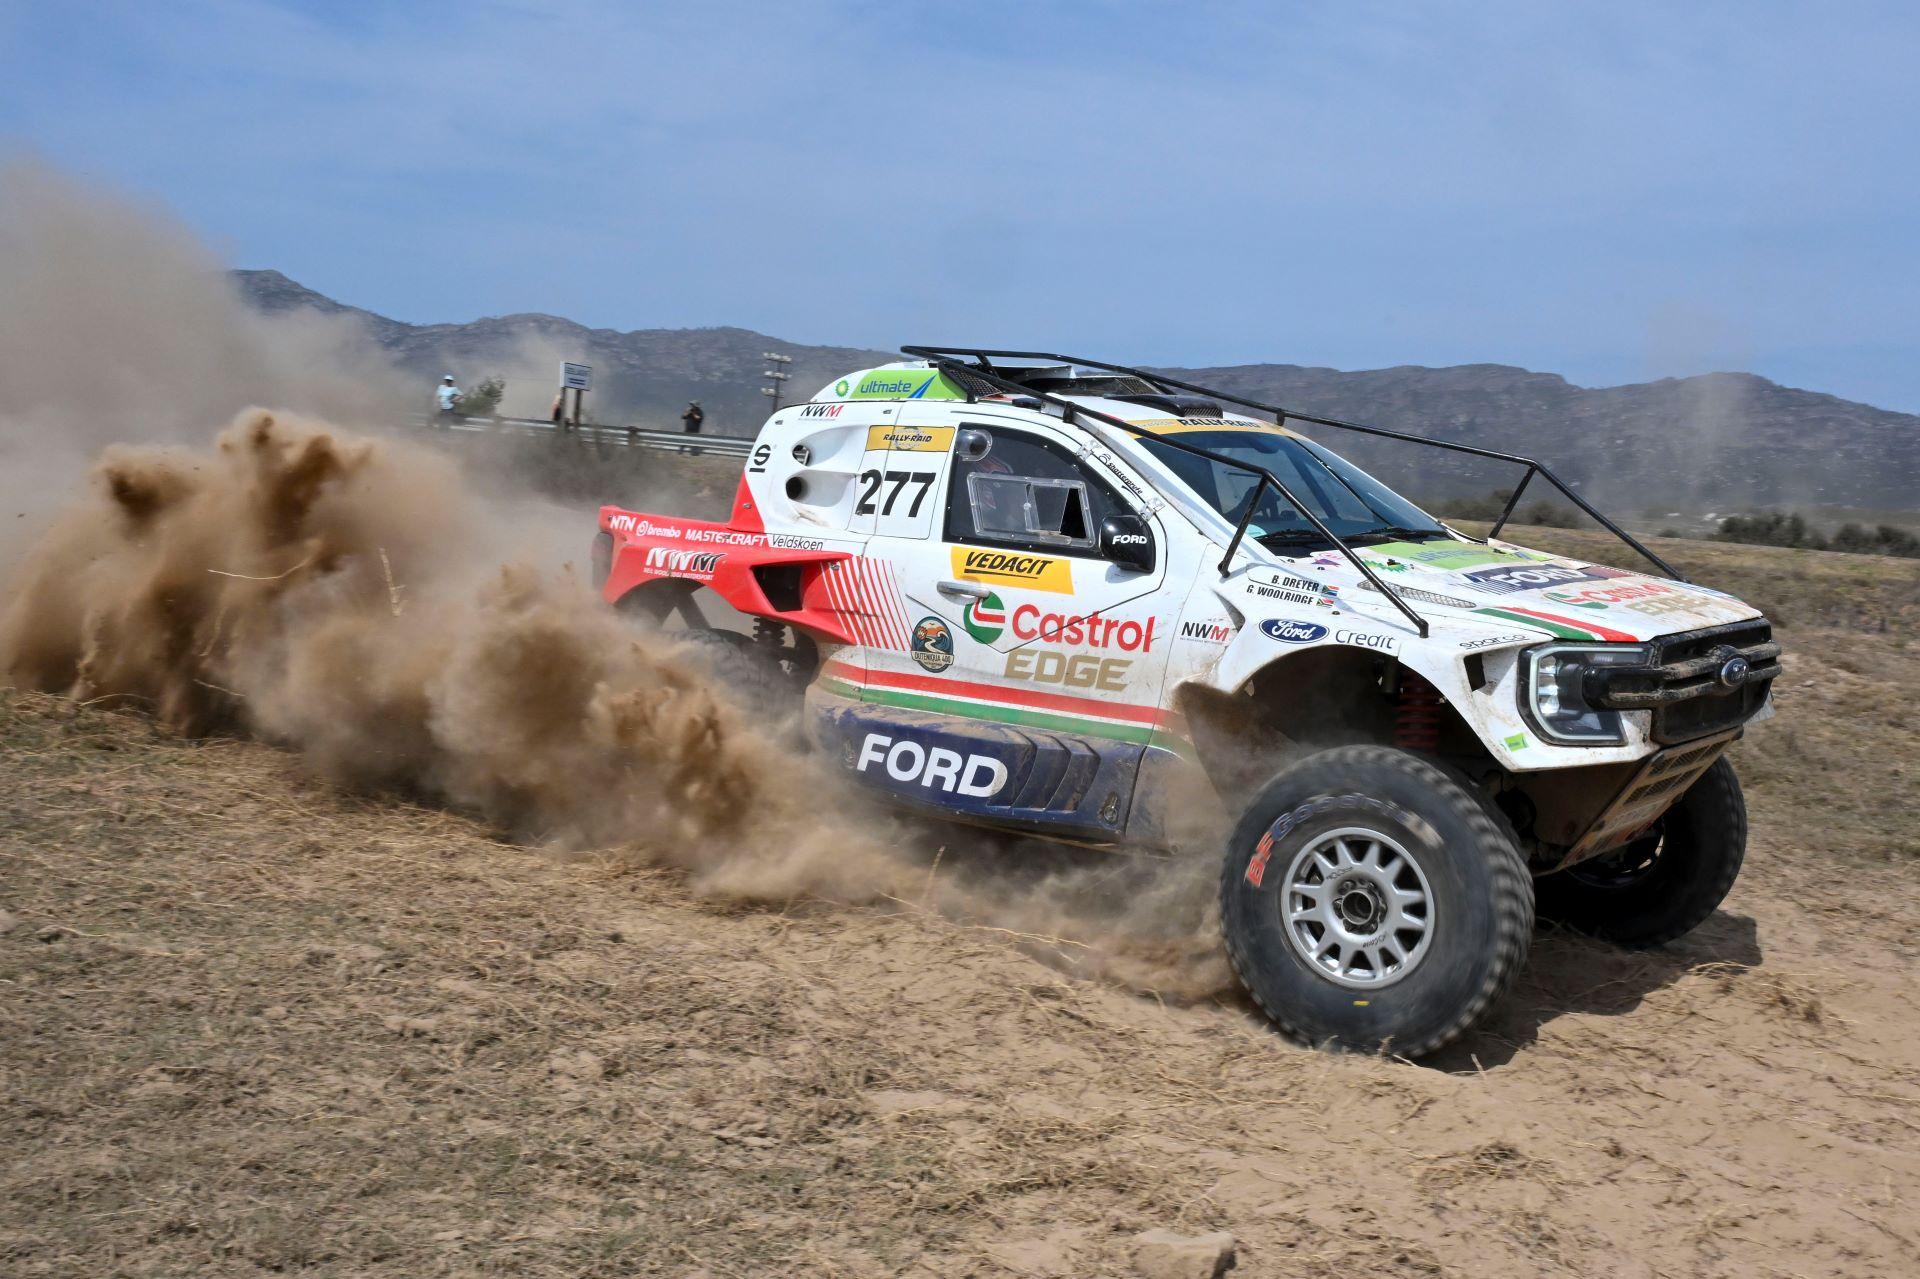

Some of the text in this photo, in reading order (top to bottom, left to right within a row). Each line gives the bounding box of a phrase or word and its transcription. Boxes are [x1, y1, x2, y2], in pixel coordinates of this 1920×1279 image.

[860, 380, 912, 394] ultimate
[800, 404, 844, 417] NWM
[883, 434, 932, 443] RALLY-RAID
[854, 469, 937, 518] 277
[609, 515, 637, 531] NTN
[647, 524, 681, 538] brembo
[772, 534, 824, 551] Veldskoen
[1112, 534, 1148, 545] FORD
[645, 547, 728, 573] NWM
[965, 551, 1054, 576] VEDACIT
[1271, 574, 1320, 592] B. DREYER
[1246, 584, 1314, 605] G. WOOLRIDGE
[1012, 603, 1156, 653] Castrol
[1181, 621, 1230, 641] NWM
[1271, 620, 1317, 640] Ford
[1335, 629, 1396, 649] Credit
[1460, 634, 1527, 649] sparco
[1003, 650, 1134, 692] EDGE
[856, 733, 1008, 798] FORD
